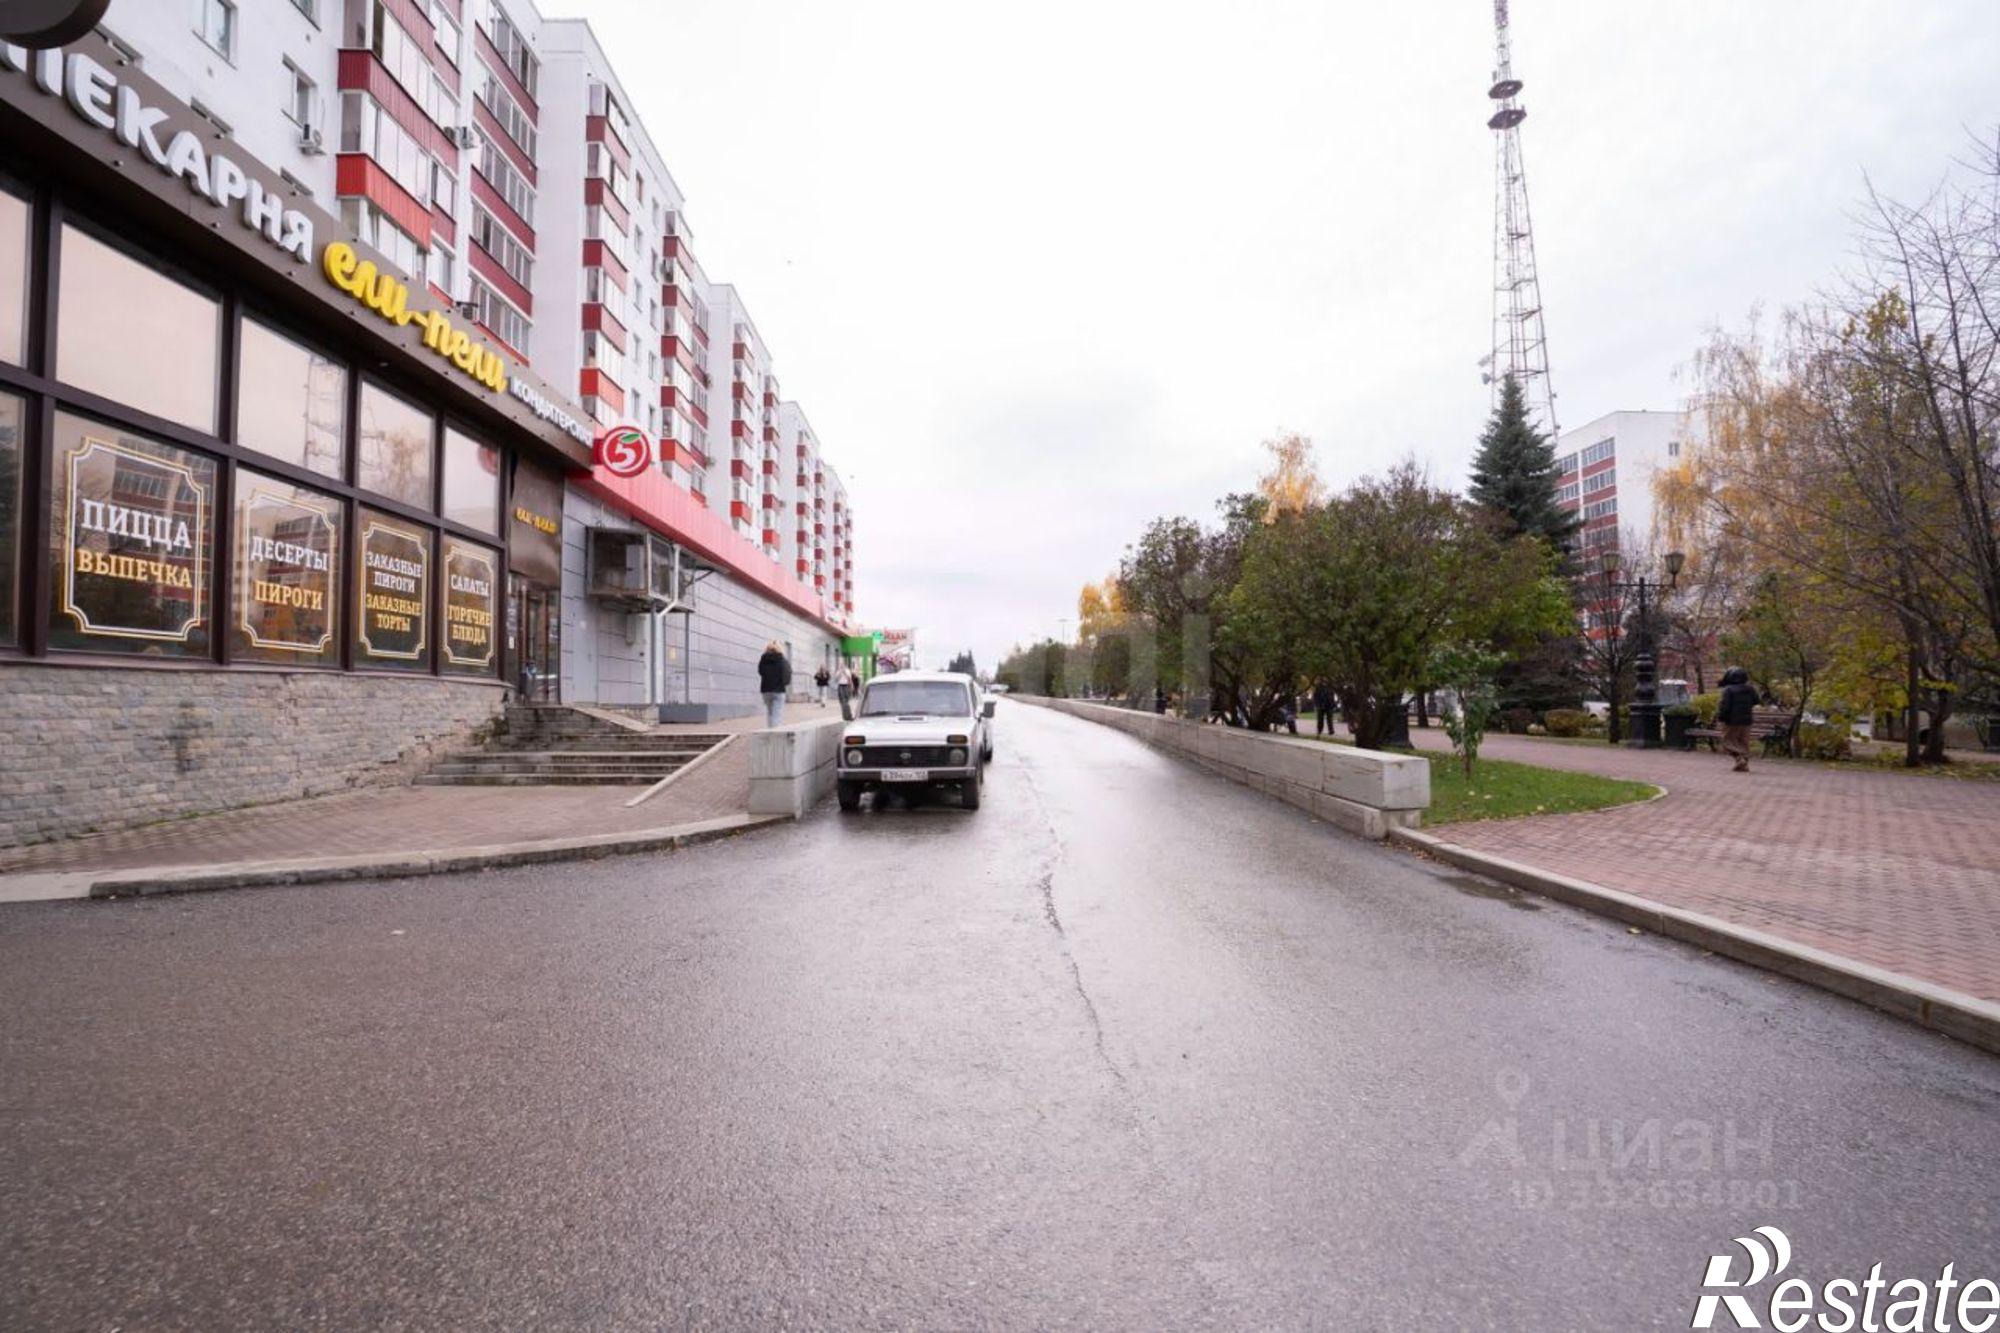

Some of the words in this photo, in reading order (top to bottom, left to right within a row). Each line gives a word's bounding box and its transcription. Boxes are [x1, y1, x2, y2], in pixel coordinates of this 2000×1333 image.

[611, 434, 640, 470] 5
[81, 498, 192, 550] ПИЦЦА
[251, 535, 328, 571] ДЕСЕРТЫ
[366, 551, 422, 578] ЗАКАЗНЫЕ
[77, 548, 193, 588] ВЫПЕЧКА
[254, 579, 324, 610] ПИРОГИ
[374, 571, 415, 593] ПИРОГИ
[450, 574, 490, 598] САЛАТЫ
[366, 593, 422, 616] ЗАКАЗНЫЕ
[448, 604, 492, 627] ГОРЯЧИЕ
[377, 613, 411, 632] ТОРТЫ
[452, 624, 487, 646] БЛЮДА
